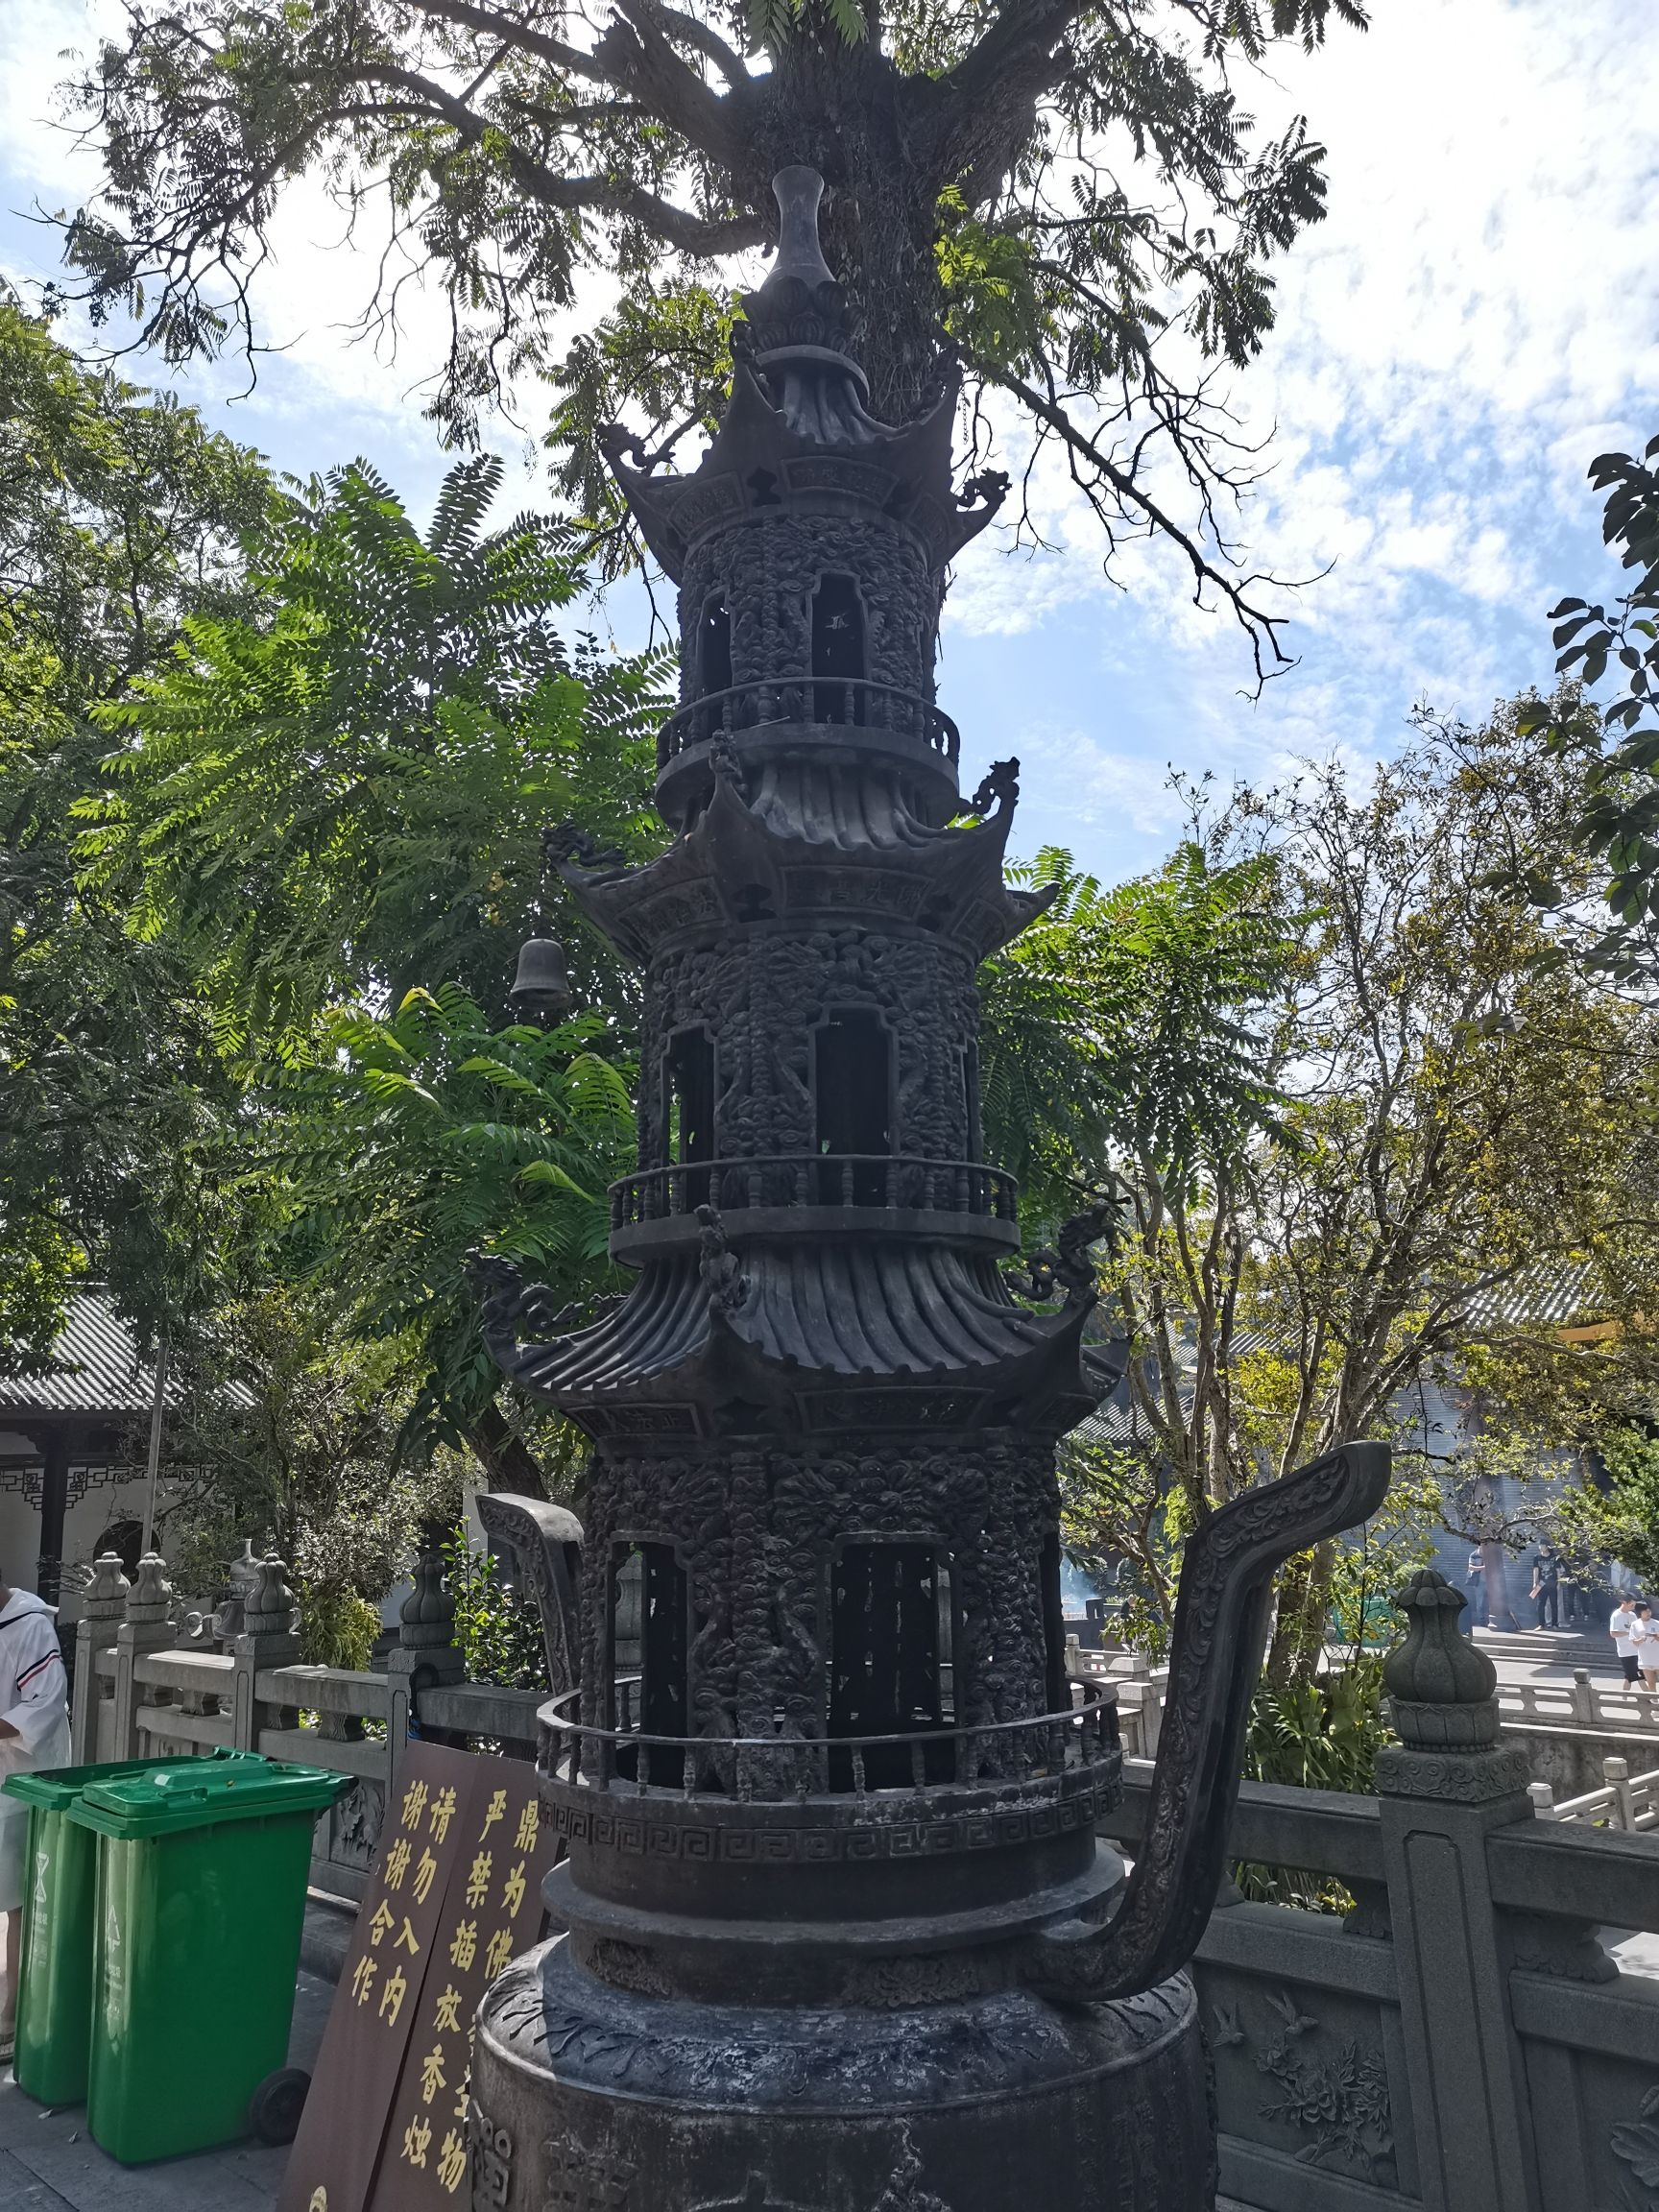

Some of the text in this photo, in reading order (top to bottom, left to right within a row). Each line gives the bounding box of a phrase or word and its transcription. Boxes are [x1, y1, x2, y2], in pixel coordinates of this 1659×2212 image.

[351, 1780, 428, 2006] 谢谢合作
[378, 1787, 457, 2028] 请勿入内
[400, 1789, 508, 2168] 严禁插放香烛
